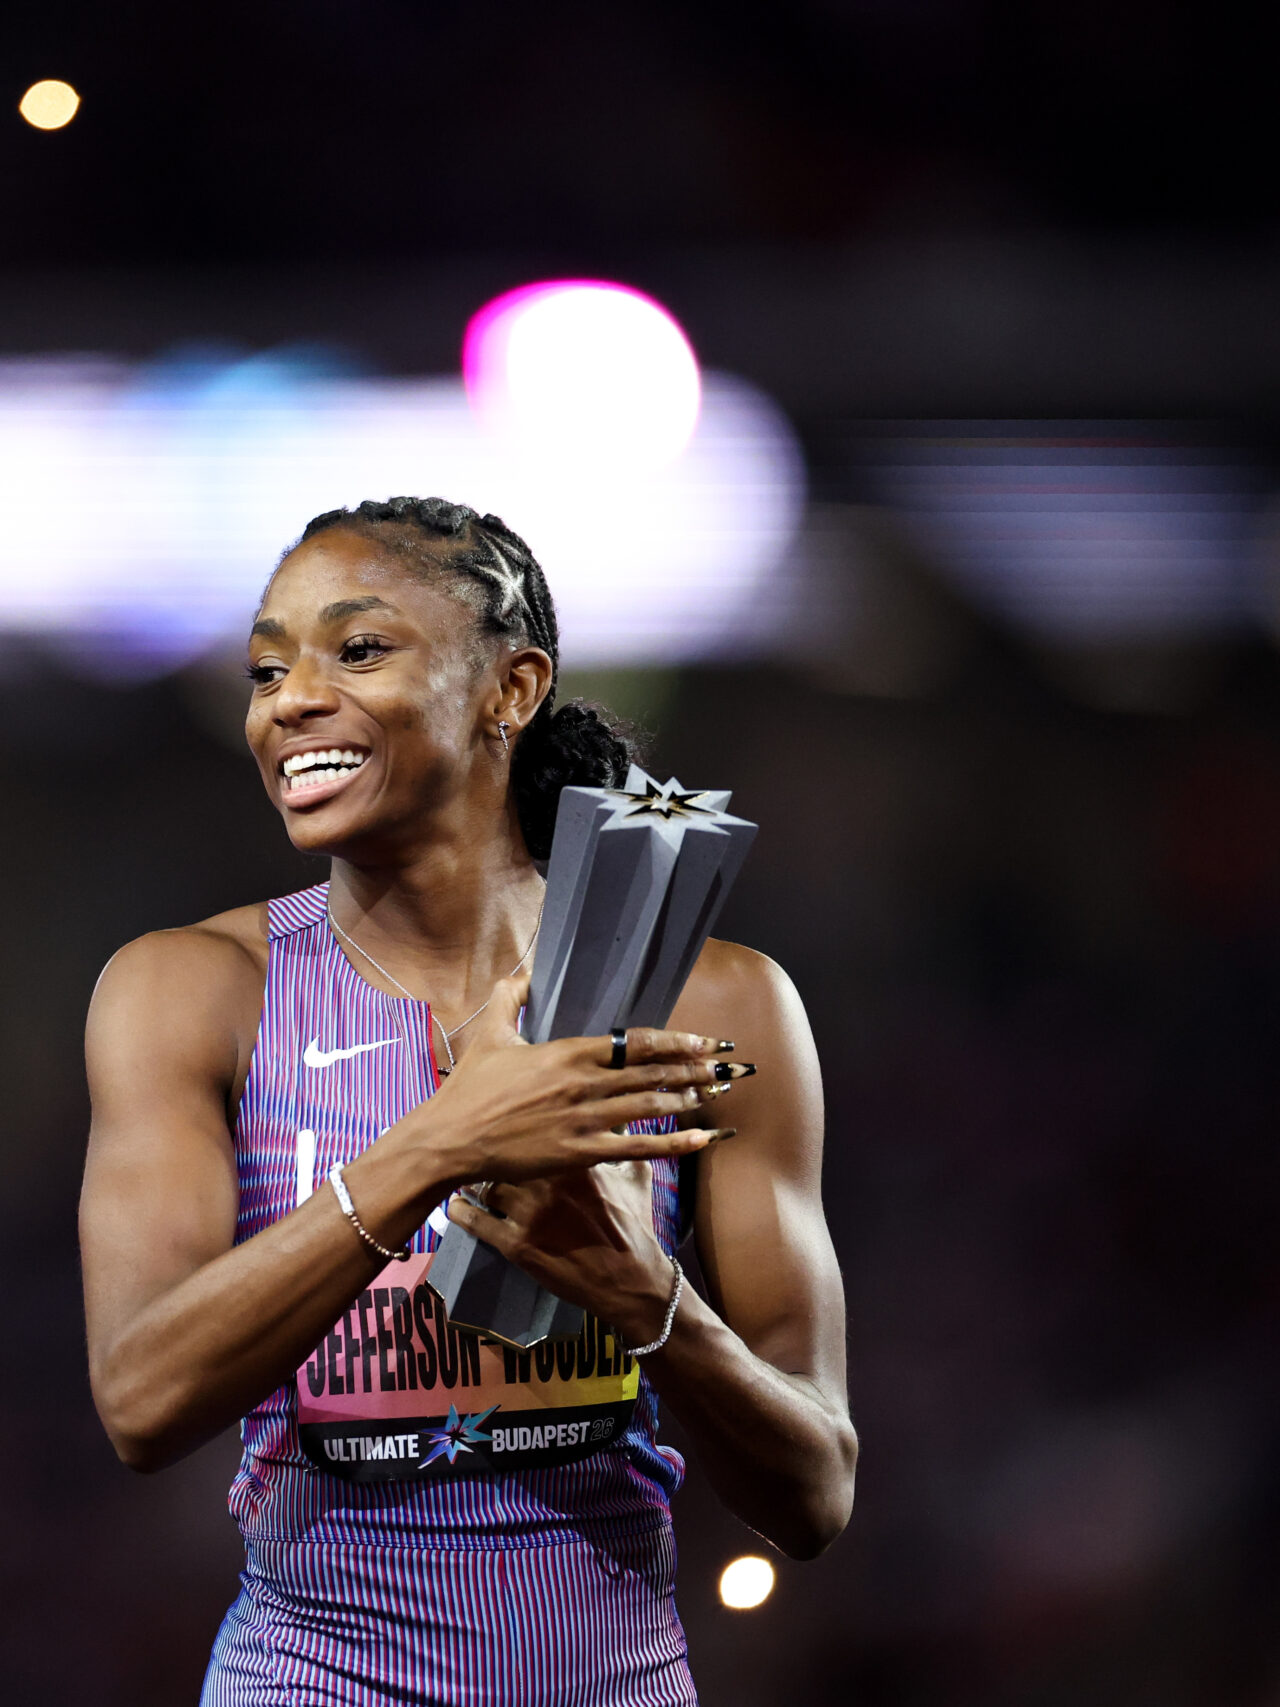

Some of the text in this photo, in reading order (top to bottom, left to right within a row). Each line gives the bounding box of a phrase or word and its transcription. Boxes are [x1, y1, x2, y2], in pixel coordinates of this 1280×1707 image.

[306, 1284, 632, 1398] JEFFERSON-DE
[323, 1433, 420, 1462] ULTIMATE
[492, 1421, 590, 1452] BUDAPEST
